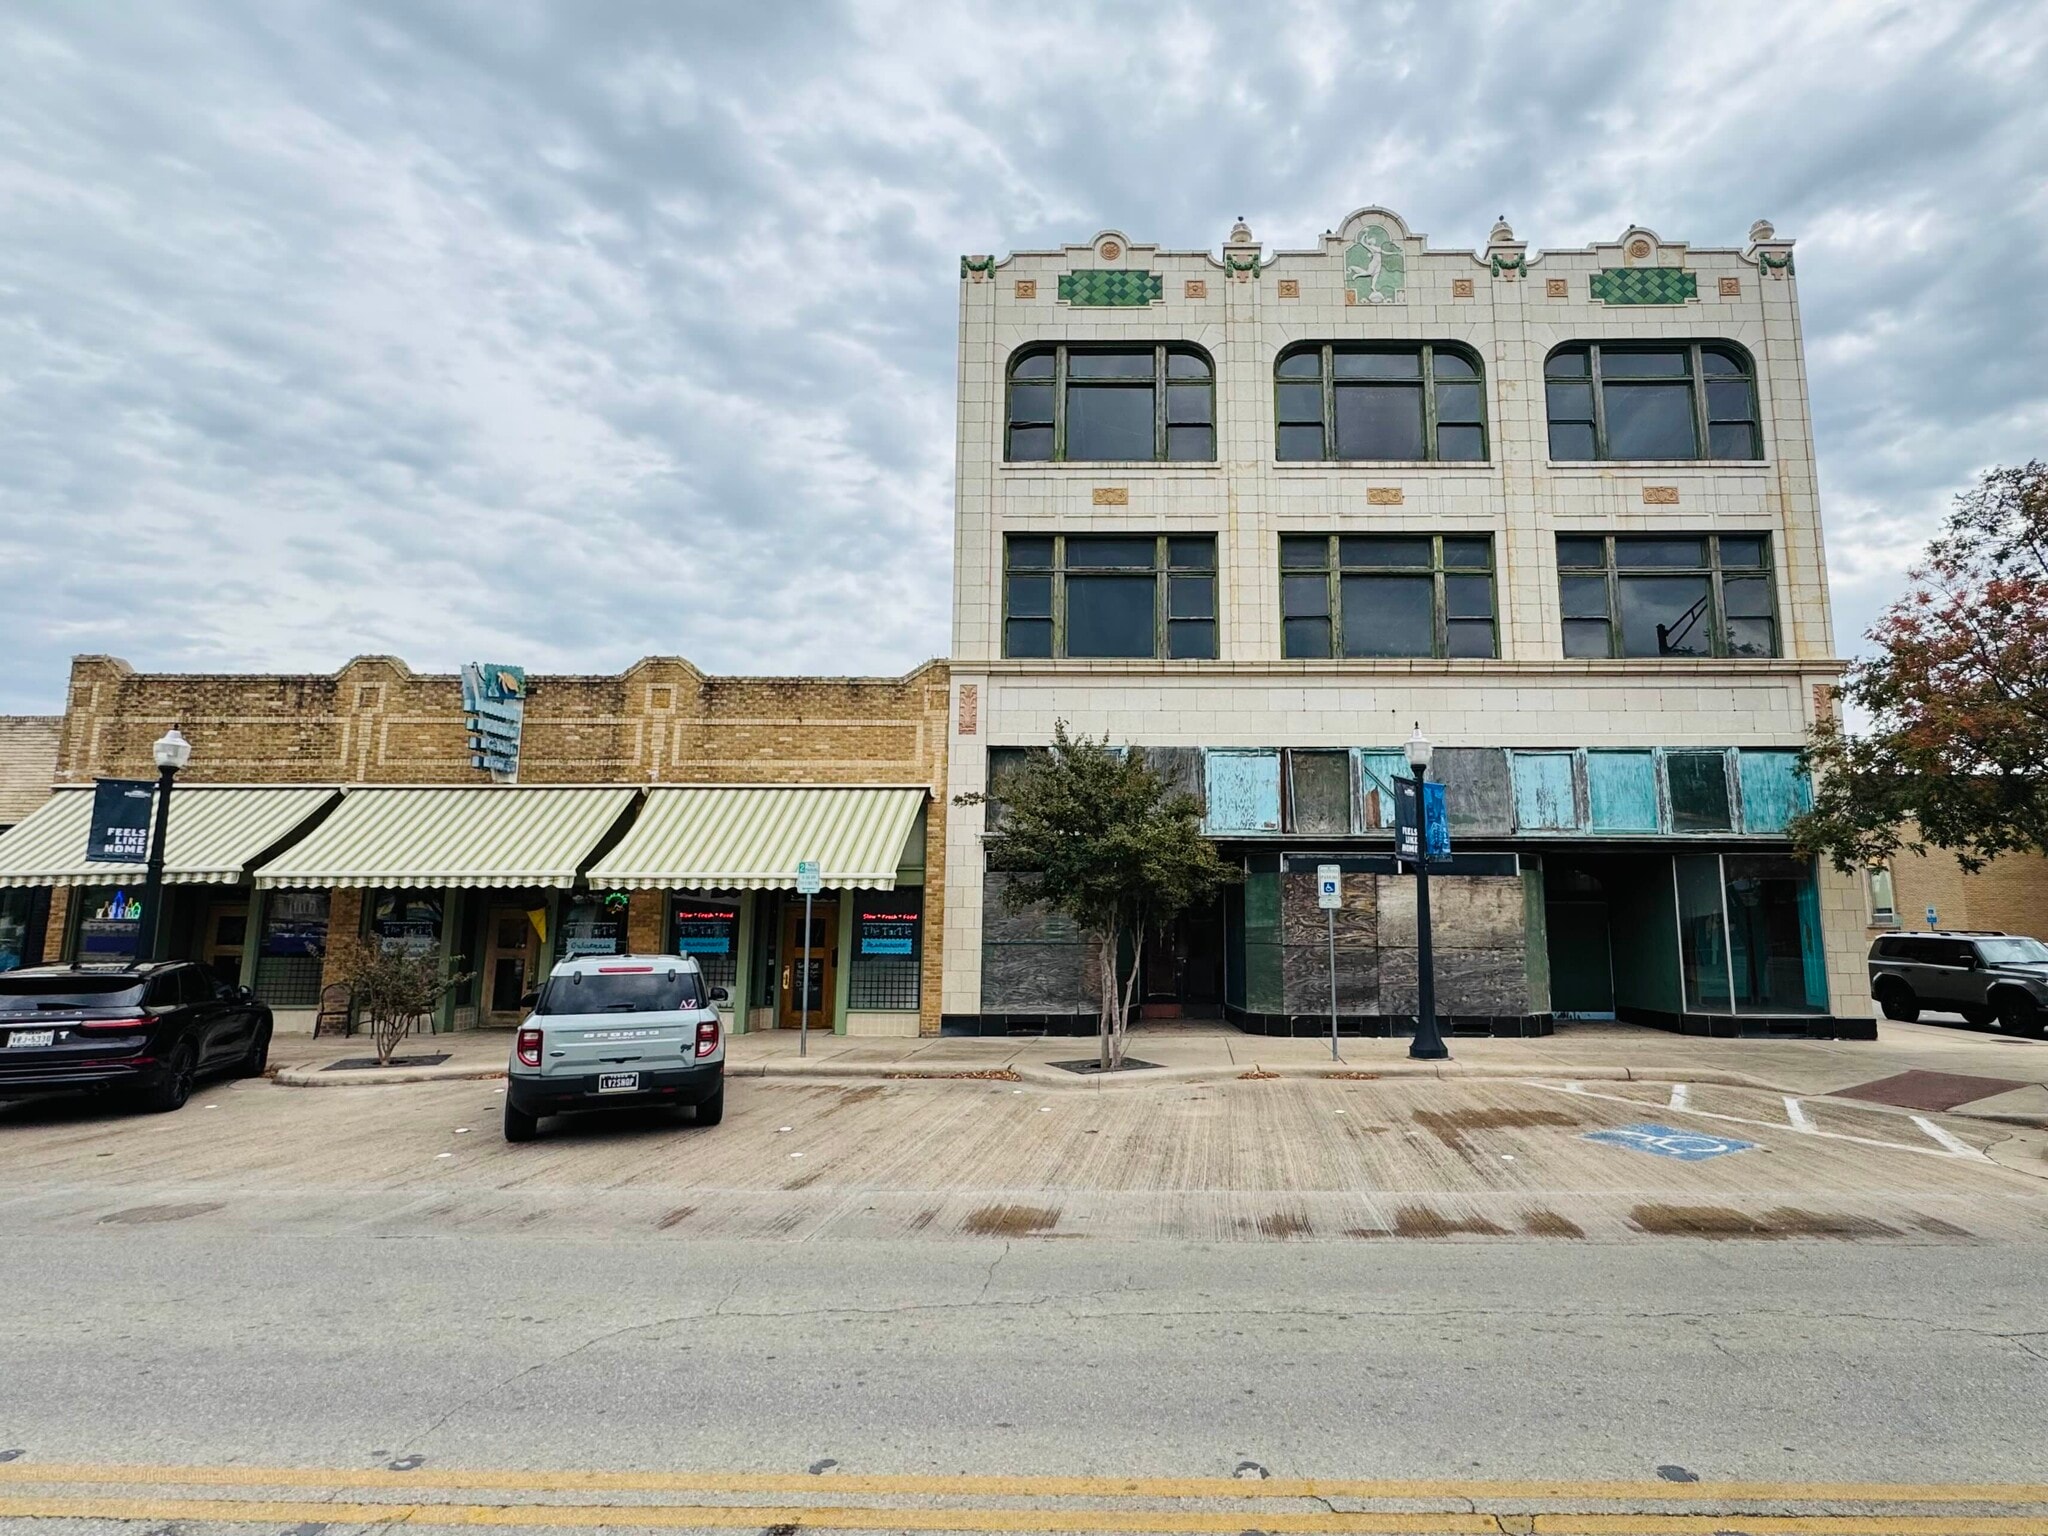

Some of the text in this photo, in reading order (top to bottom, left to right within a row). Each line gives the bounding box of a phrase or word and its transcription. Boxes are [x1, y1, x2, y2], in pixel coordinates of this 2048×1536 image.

[107, 827, 147, 837] FEELS
[1402, 826, 1418, 836] FEELS
[114, 836, 146, 845] LIKE
[103, 844, 145, 854] HOME
[800, 863, 805, 872] 2
[583, 1030, 660, 1039] BRONCO
